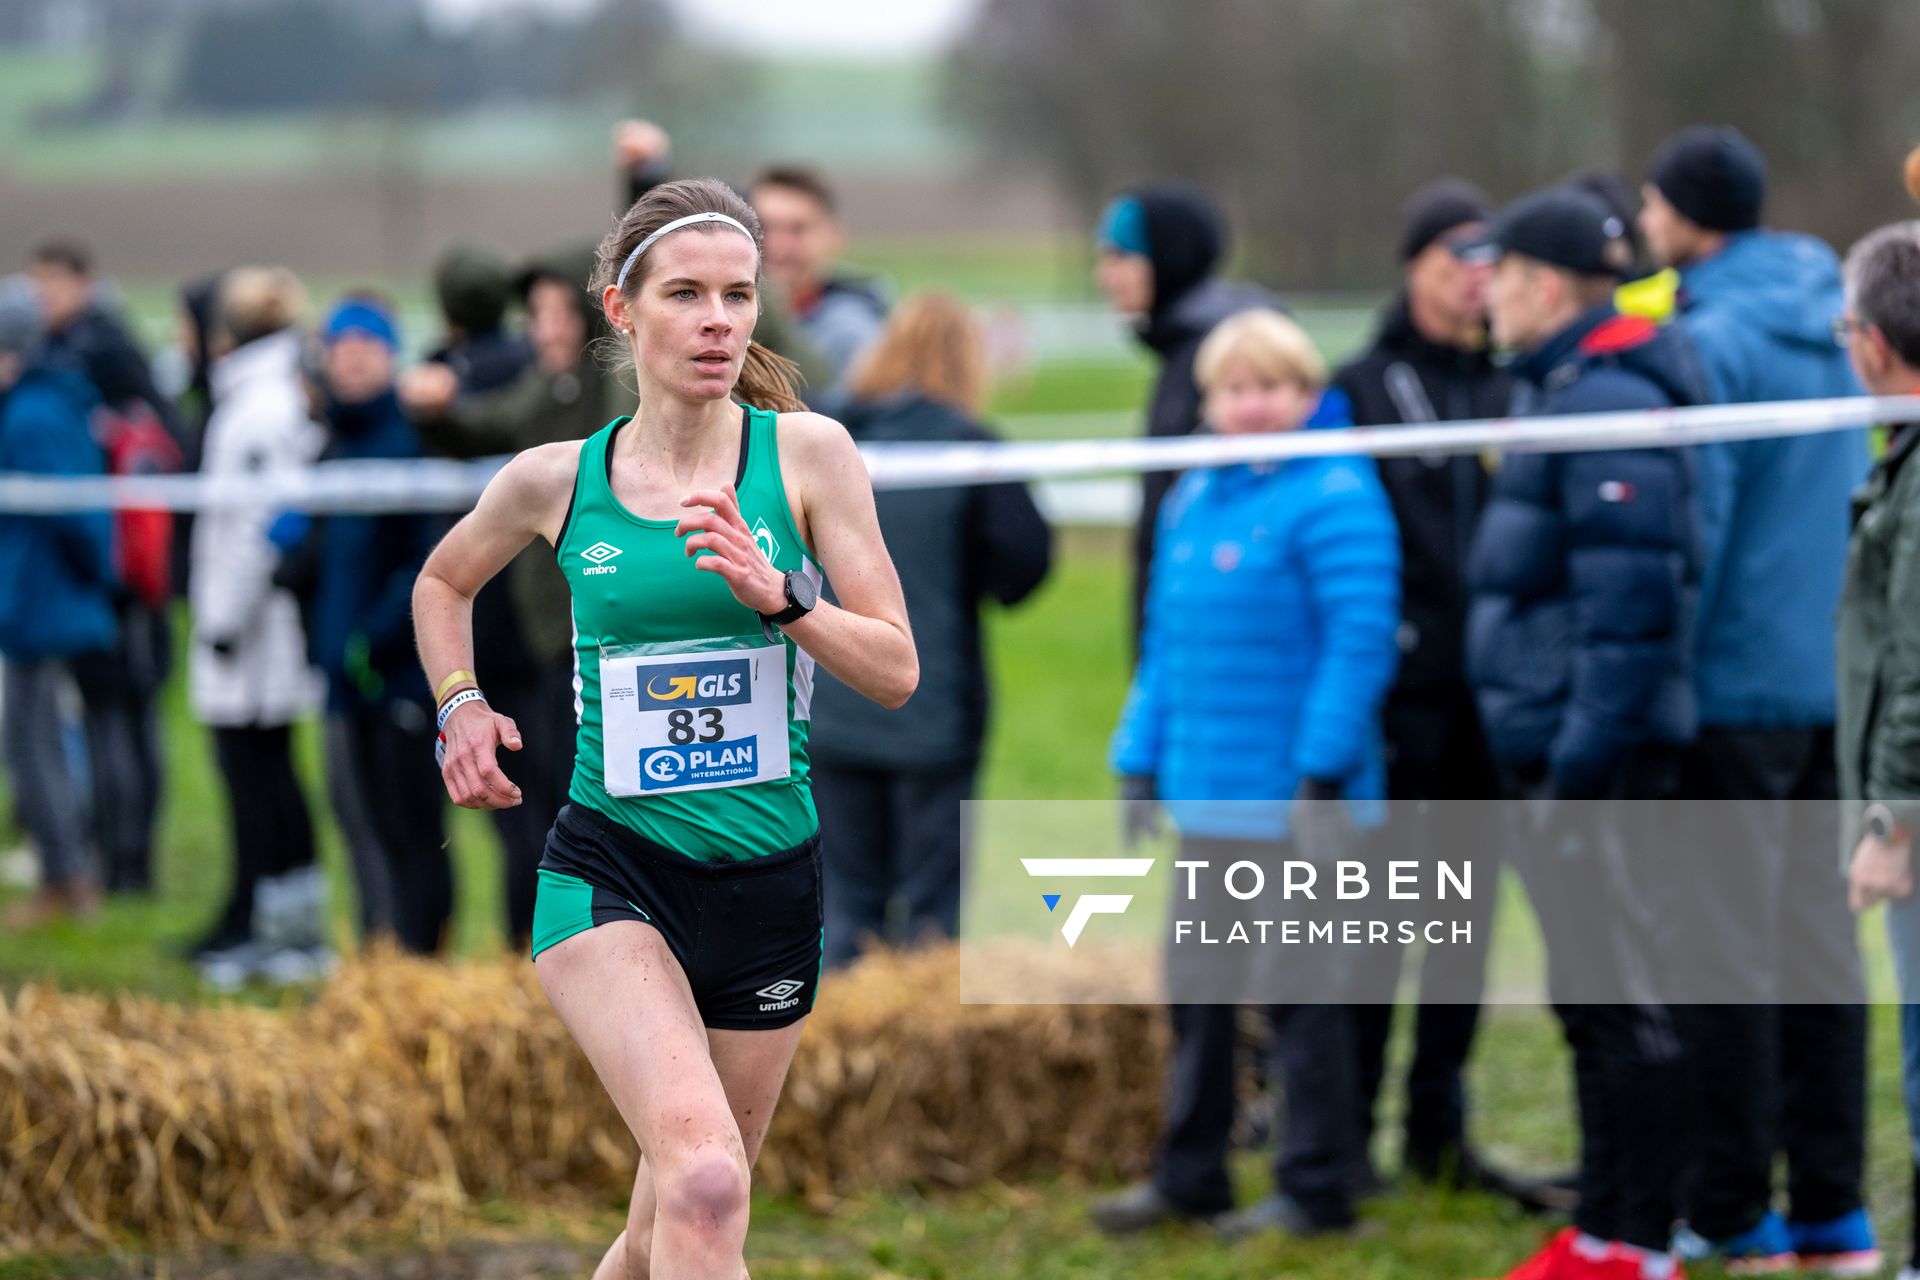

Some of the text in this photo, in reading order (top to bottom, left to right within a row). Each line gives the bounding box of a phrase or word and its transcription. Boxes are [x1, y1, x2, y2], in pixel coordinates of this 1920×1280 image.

[583, 564, 617, 576] umbro
[697, 673, 741, 698] GLS
[667, 707, 725, 746] 83
[690, 746, 753, 769] PLAN
[691, 766, 753, 779] INTERNATIONAL
[759, 997, 799, 1012] umbro
